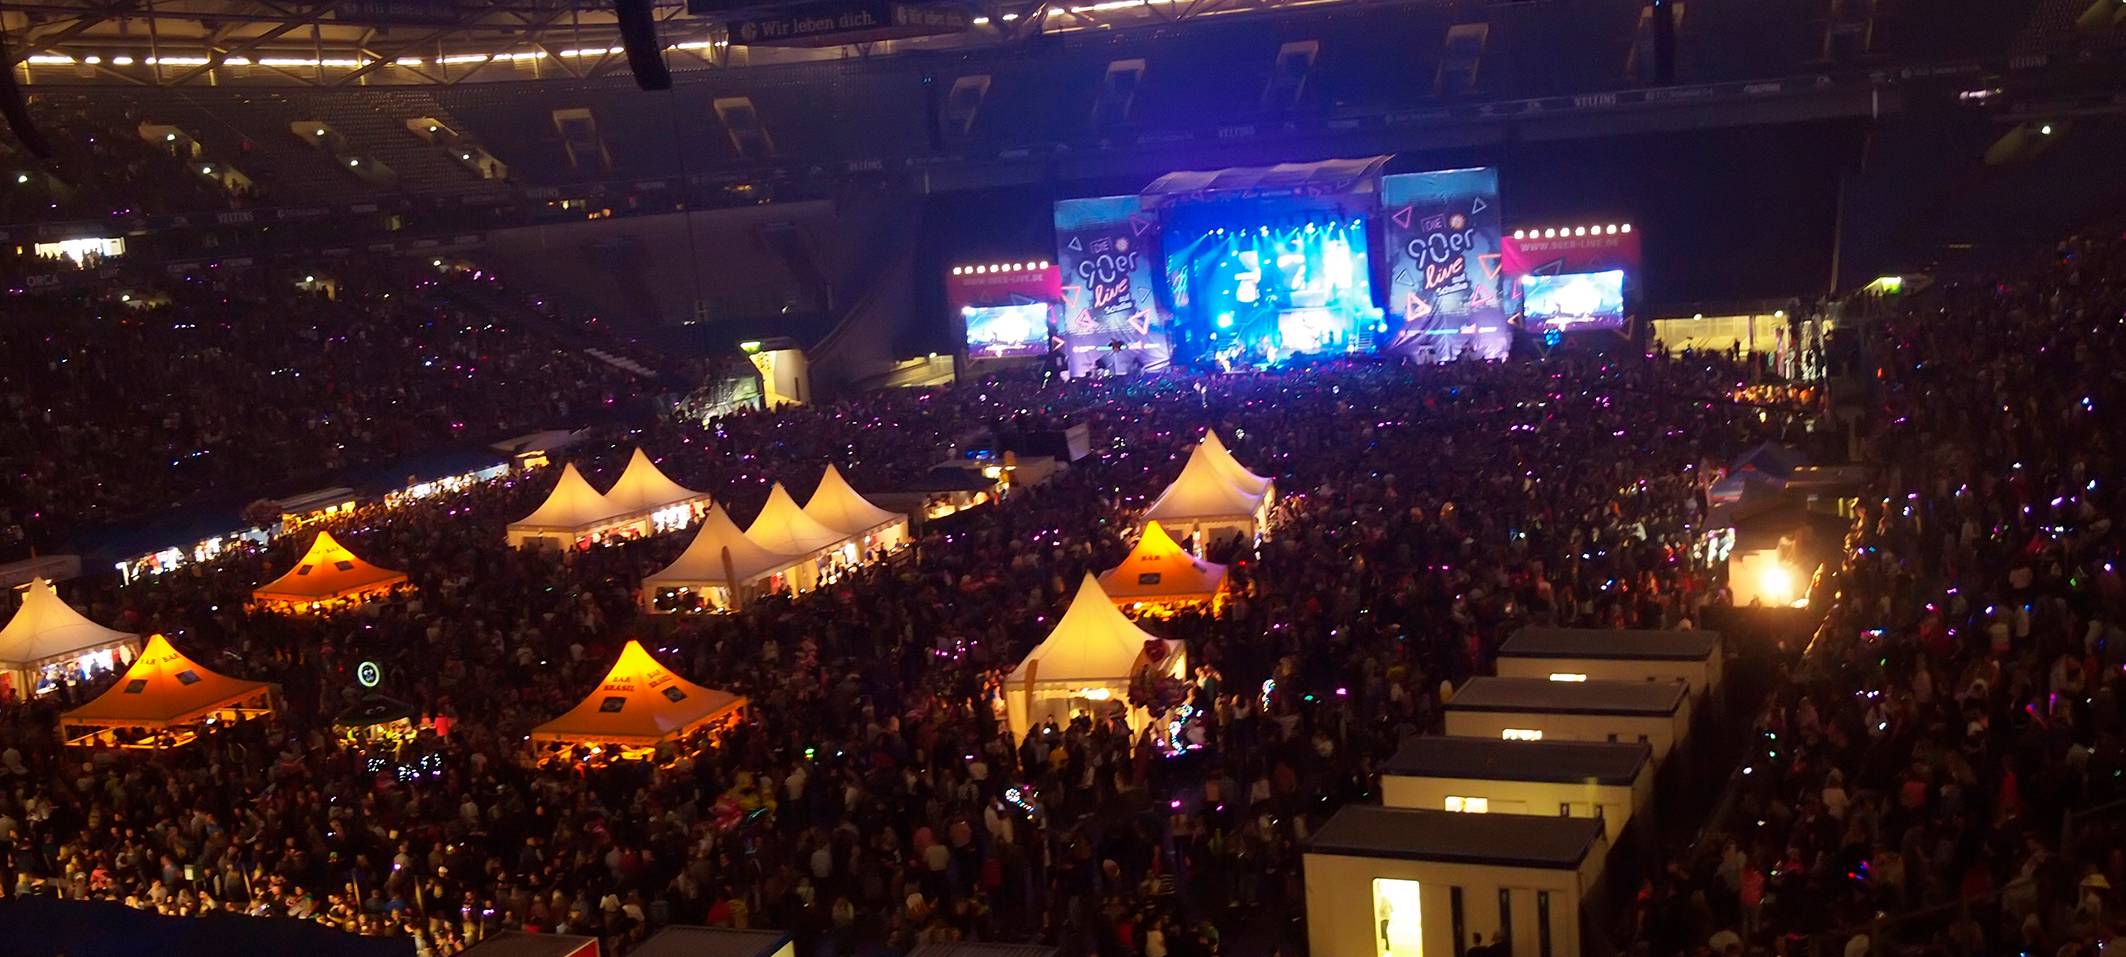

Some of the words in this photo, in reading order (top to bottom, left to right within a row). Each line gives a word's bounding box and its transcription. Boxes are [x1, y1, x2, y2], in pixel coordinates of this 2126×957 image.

[761, 21, 790, 36] Wir
[793, 16, 835, 33] leben
[839, 10, 877, 28] dich.
[1424, 217, 1442, 232] DIE
[1408, 228, 1475, 269] 90er
[26, 273, 60, 287] ORCA
[1079, 251, 1137, 289] 90er
[1425, 257, 1464, 290] live
[1094, 278, 1128, 308] live
